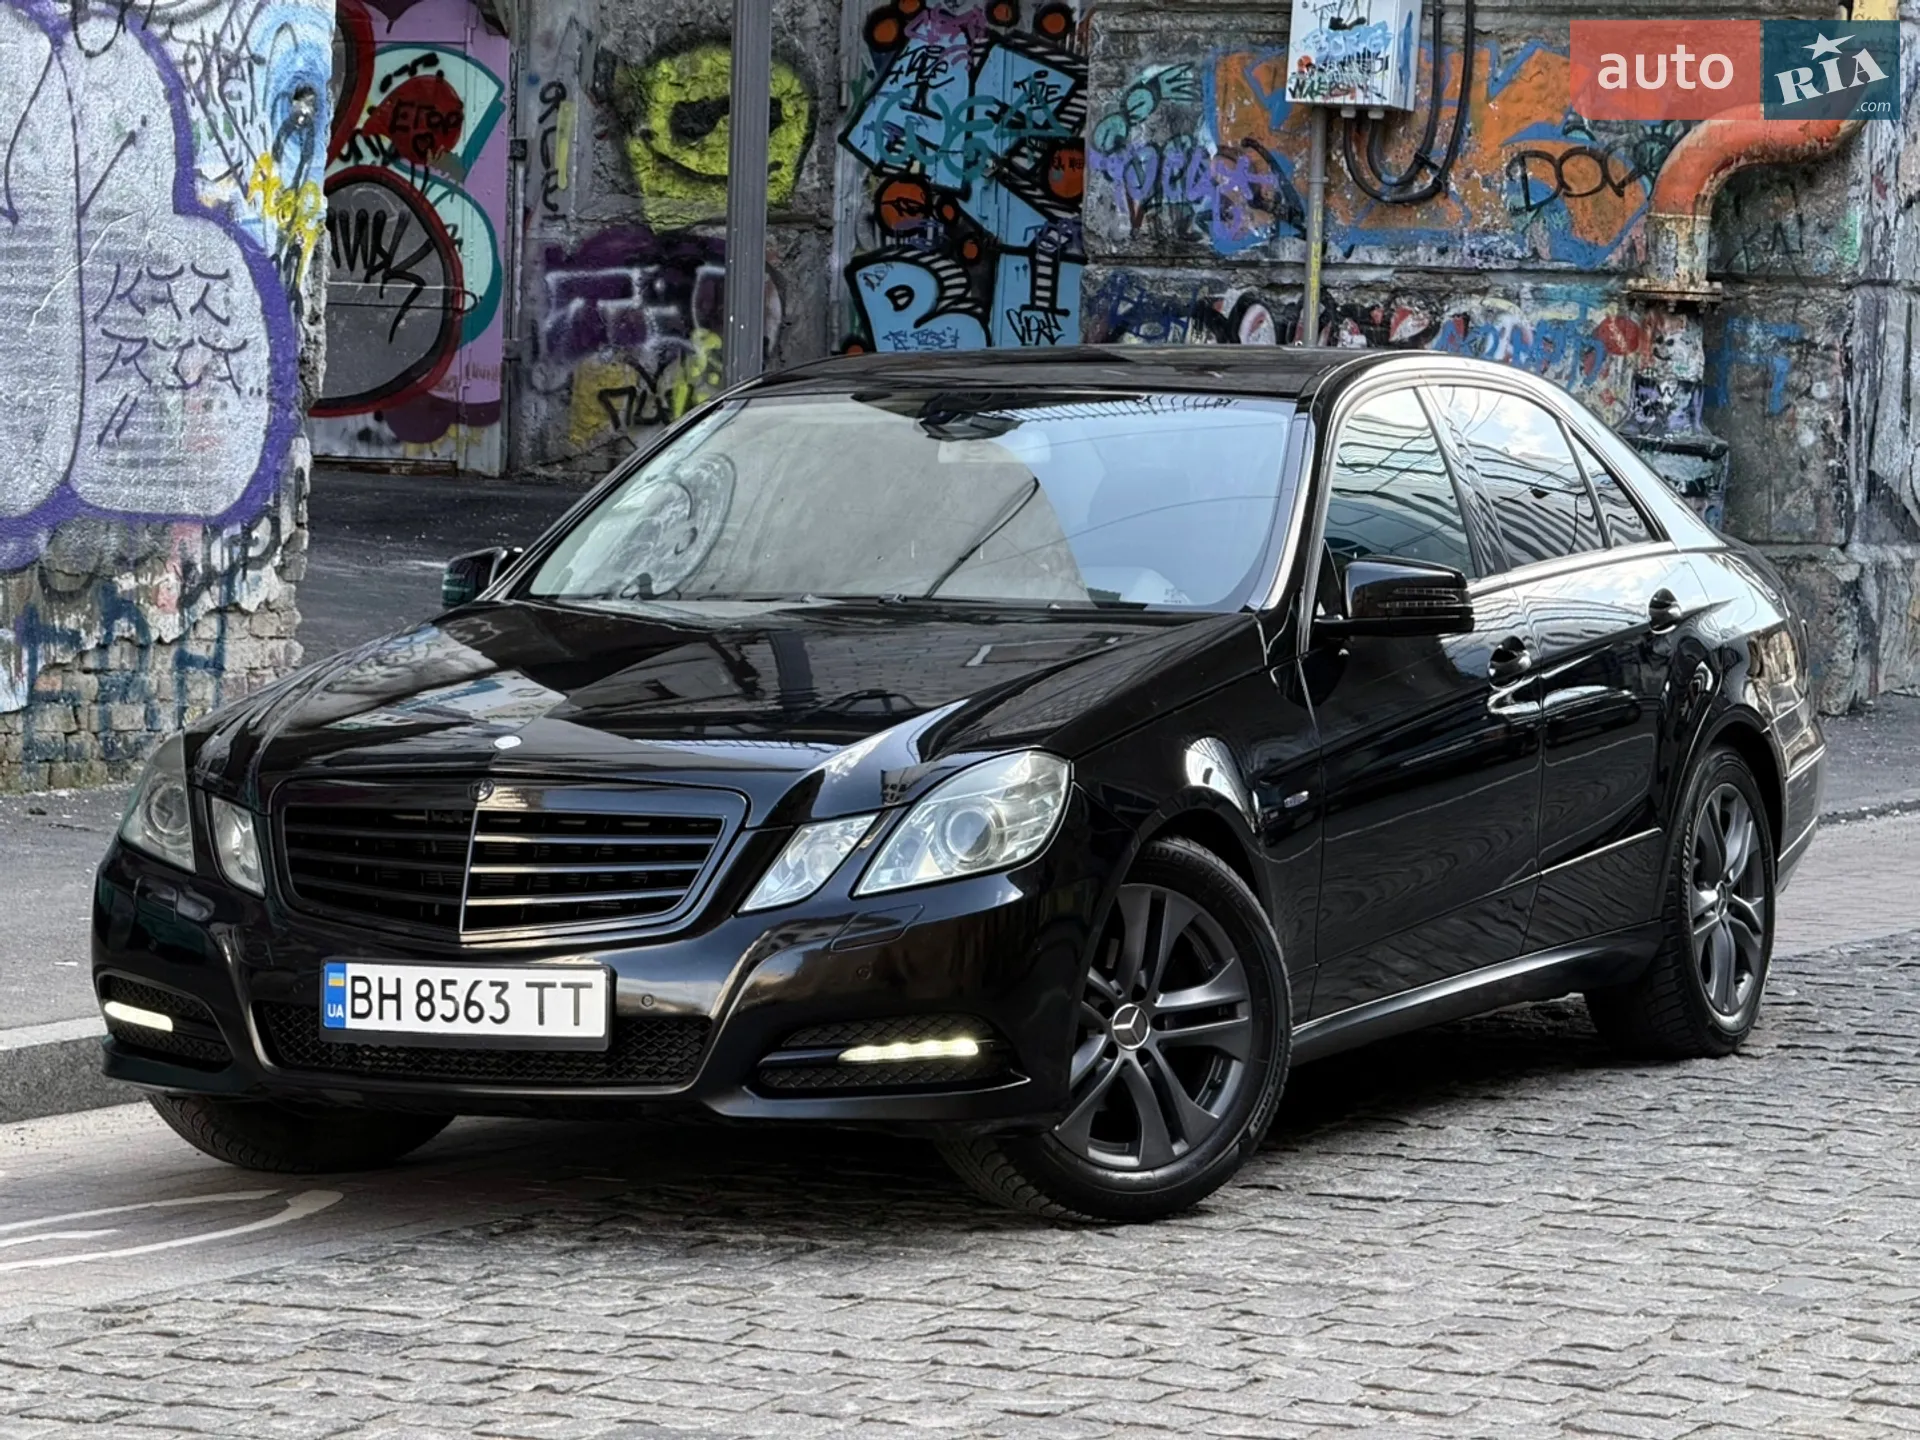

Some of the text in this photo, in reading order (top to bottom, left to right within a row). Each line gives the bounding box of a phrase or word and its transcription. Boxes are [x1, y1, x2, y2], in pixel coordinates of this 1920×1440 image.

[328, 1004, 344, 1018] UA
[350, 976, 593, 1026] BH 8563 TT
